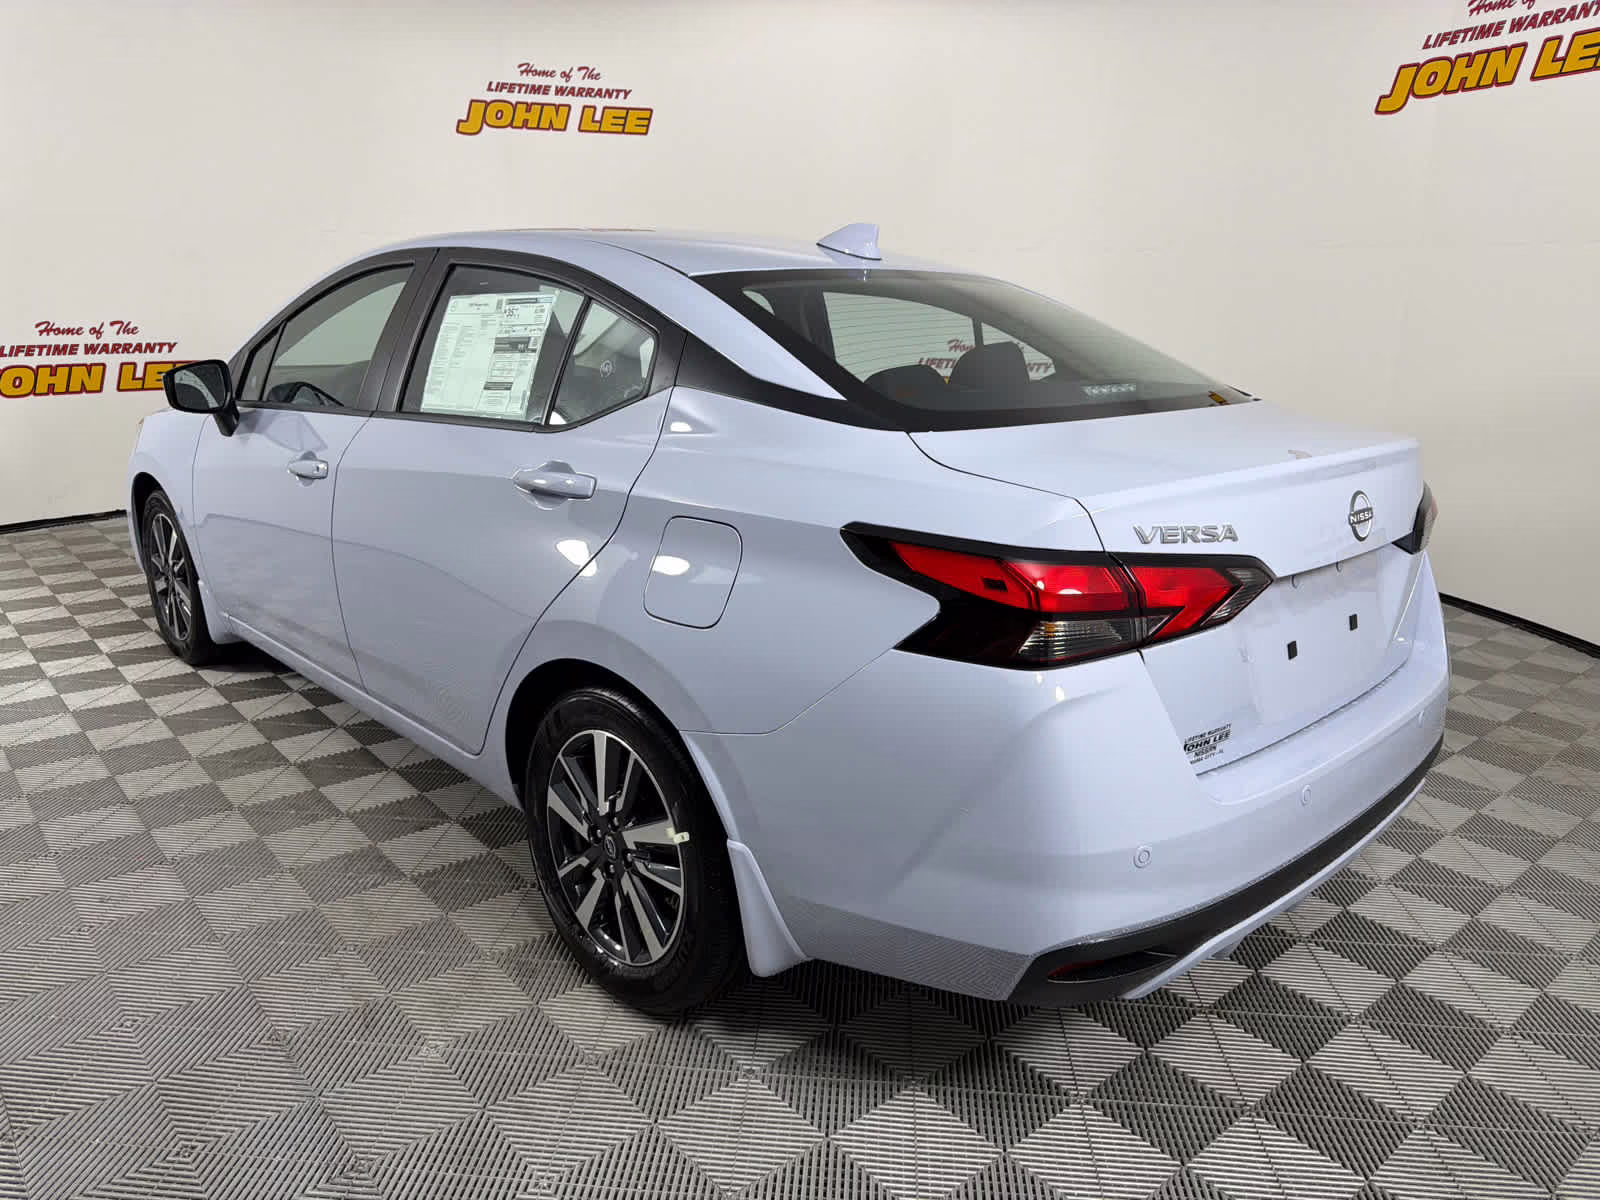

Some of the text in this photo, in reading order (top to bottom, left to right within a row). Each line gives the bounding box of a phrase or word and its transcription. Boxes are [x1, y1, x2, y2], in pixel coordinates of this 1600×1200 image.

[1468, 0, 1517, 16] Home
[1422, 20, 1506, 49] LIFETIME
[517, 62, 602, 82] Home of The
[1374, 27, 1600, 115] JOHN LE
[486, 81, 632, 100] LIFETIME WARRANTY
[456, 99, 653, 136] JOHN LEE
[35, 320, 140, 340] Home of The
[0, 342, 178, 358] LIFETIME WARRANTY
[0, 360, 198, 399] OHN LE
[1133, 524, 1239, 545] VERSA
[1212, 730, 1231, 743] LEE
